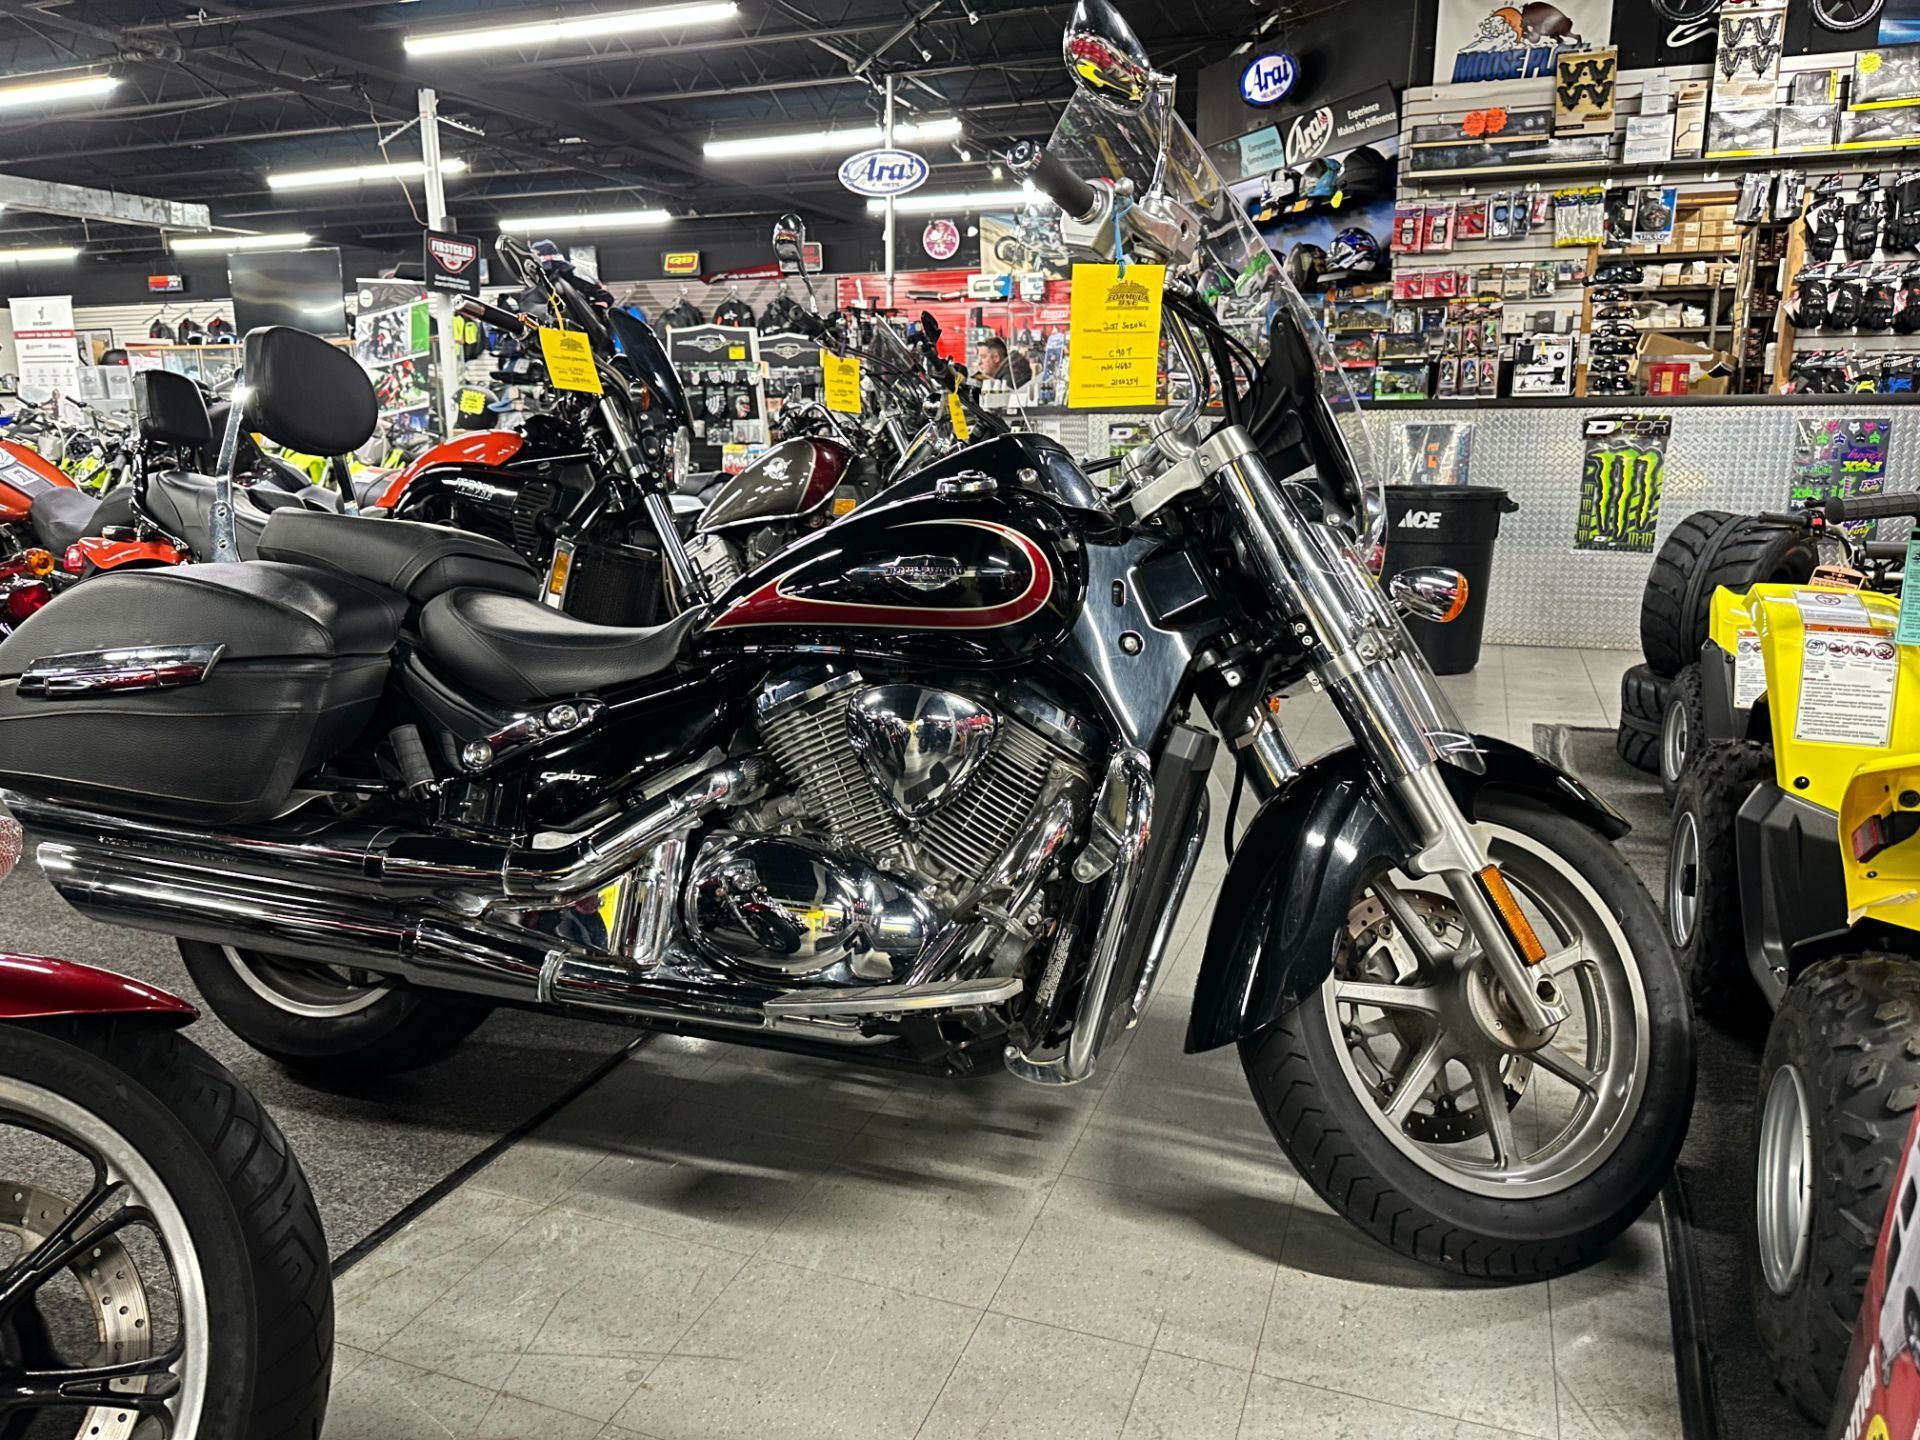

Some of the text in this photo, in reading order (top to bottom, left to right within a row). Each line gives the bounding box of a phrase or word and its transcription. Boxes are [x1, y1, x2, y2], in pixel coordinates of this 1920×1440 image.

[1246, 55, 1290, 97] Arai
[1451, 49, 1527, 83] MOOSE
[1347, 103, 1380, 120] Experience
[1292, 112, 1328, 157] Arai
[1337, 111, 1397, 137] Makes the Difference
[846, 156, 918, 181] Arai
[432, 240, 472, 258] FIRSTGEAR
[1109, 293, 1148, 301] FORMULA
[1398, 509, 1442, 528] ACE
[1837, 626, 1870, 634] WARNING
